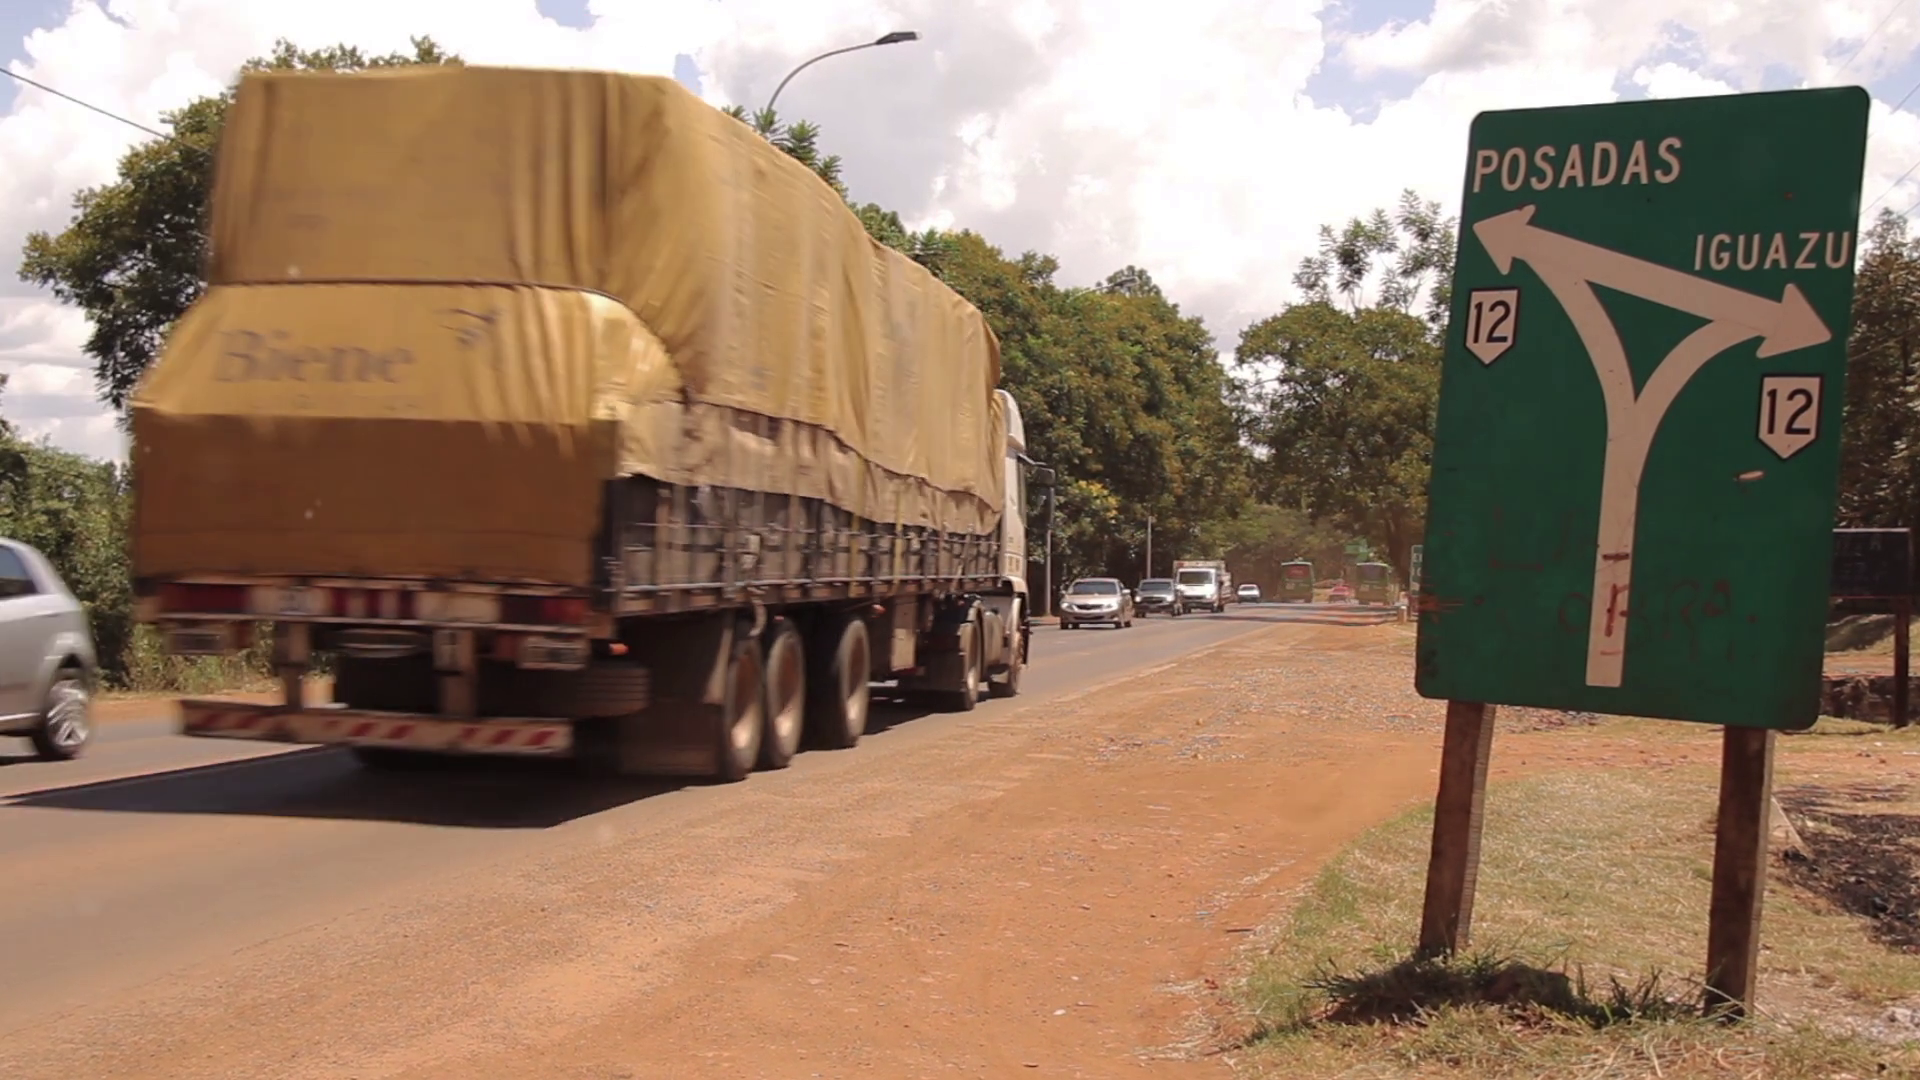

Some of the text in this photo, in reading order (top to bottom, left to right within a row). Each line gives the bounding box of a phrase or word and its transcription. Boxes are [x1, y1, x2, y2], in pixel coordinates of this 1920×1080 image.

[1473, 137, 1683, 193] POSADAS
[1693, 231, 1851, 271] IGUAZU
[1472, 299, 1511, 344] 12
[1765, 387, 1813, 435] 12
